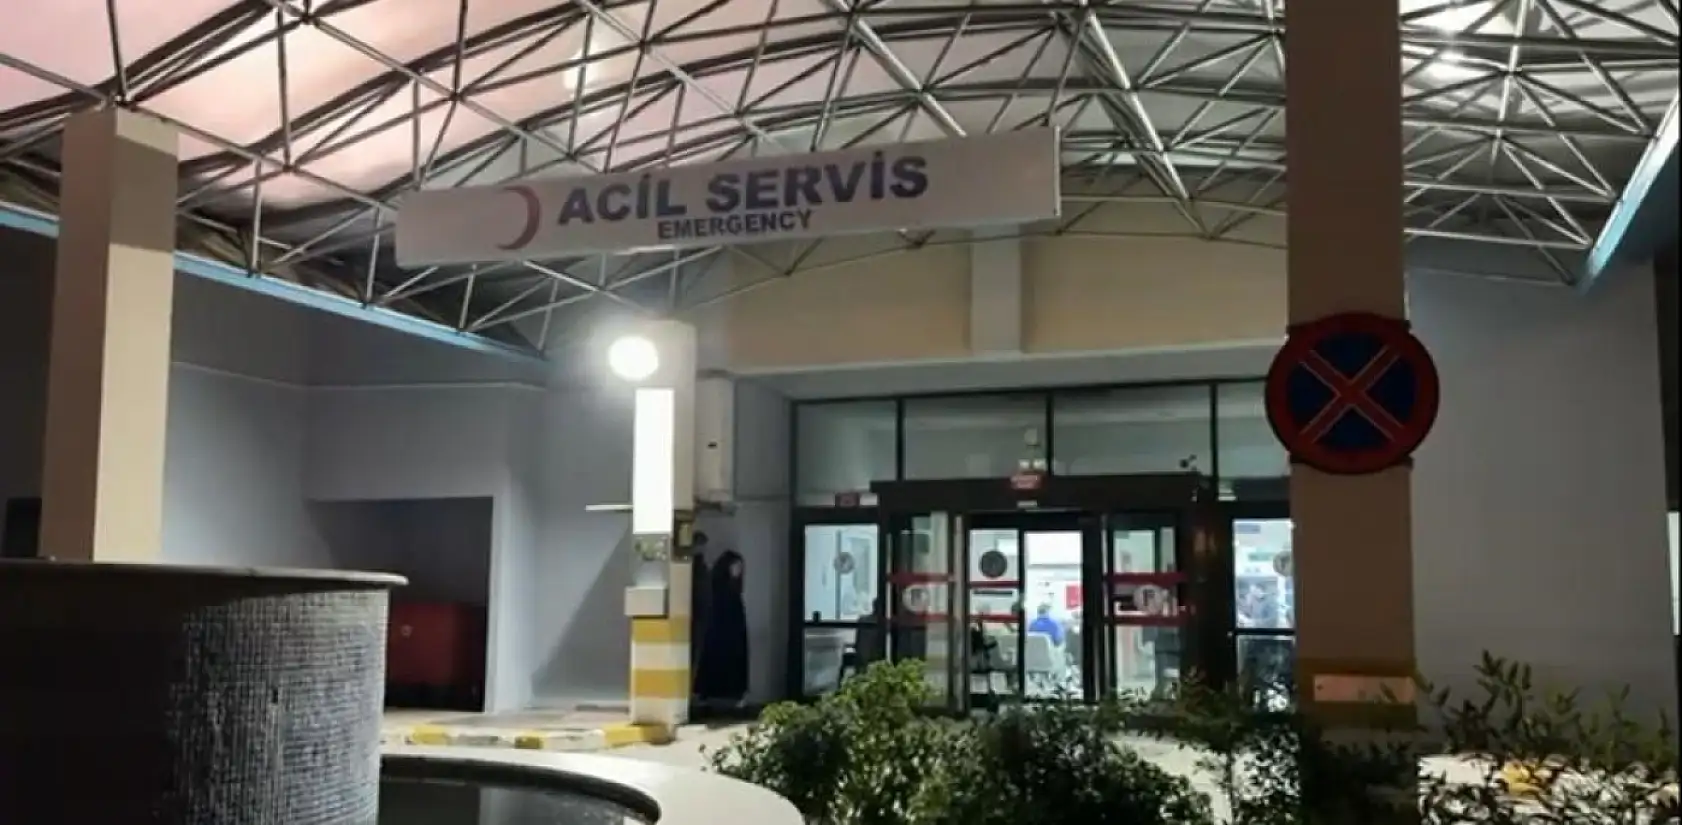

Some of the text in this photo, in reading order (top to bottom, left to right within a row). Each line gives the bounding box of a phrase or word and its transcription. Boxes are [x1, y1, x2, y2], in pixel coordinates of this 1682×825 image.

[558, 151, 928, 225] ACİL SERVİS
[658, 209, 811, 239] EMERGENCY
